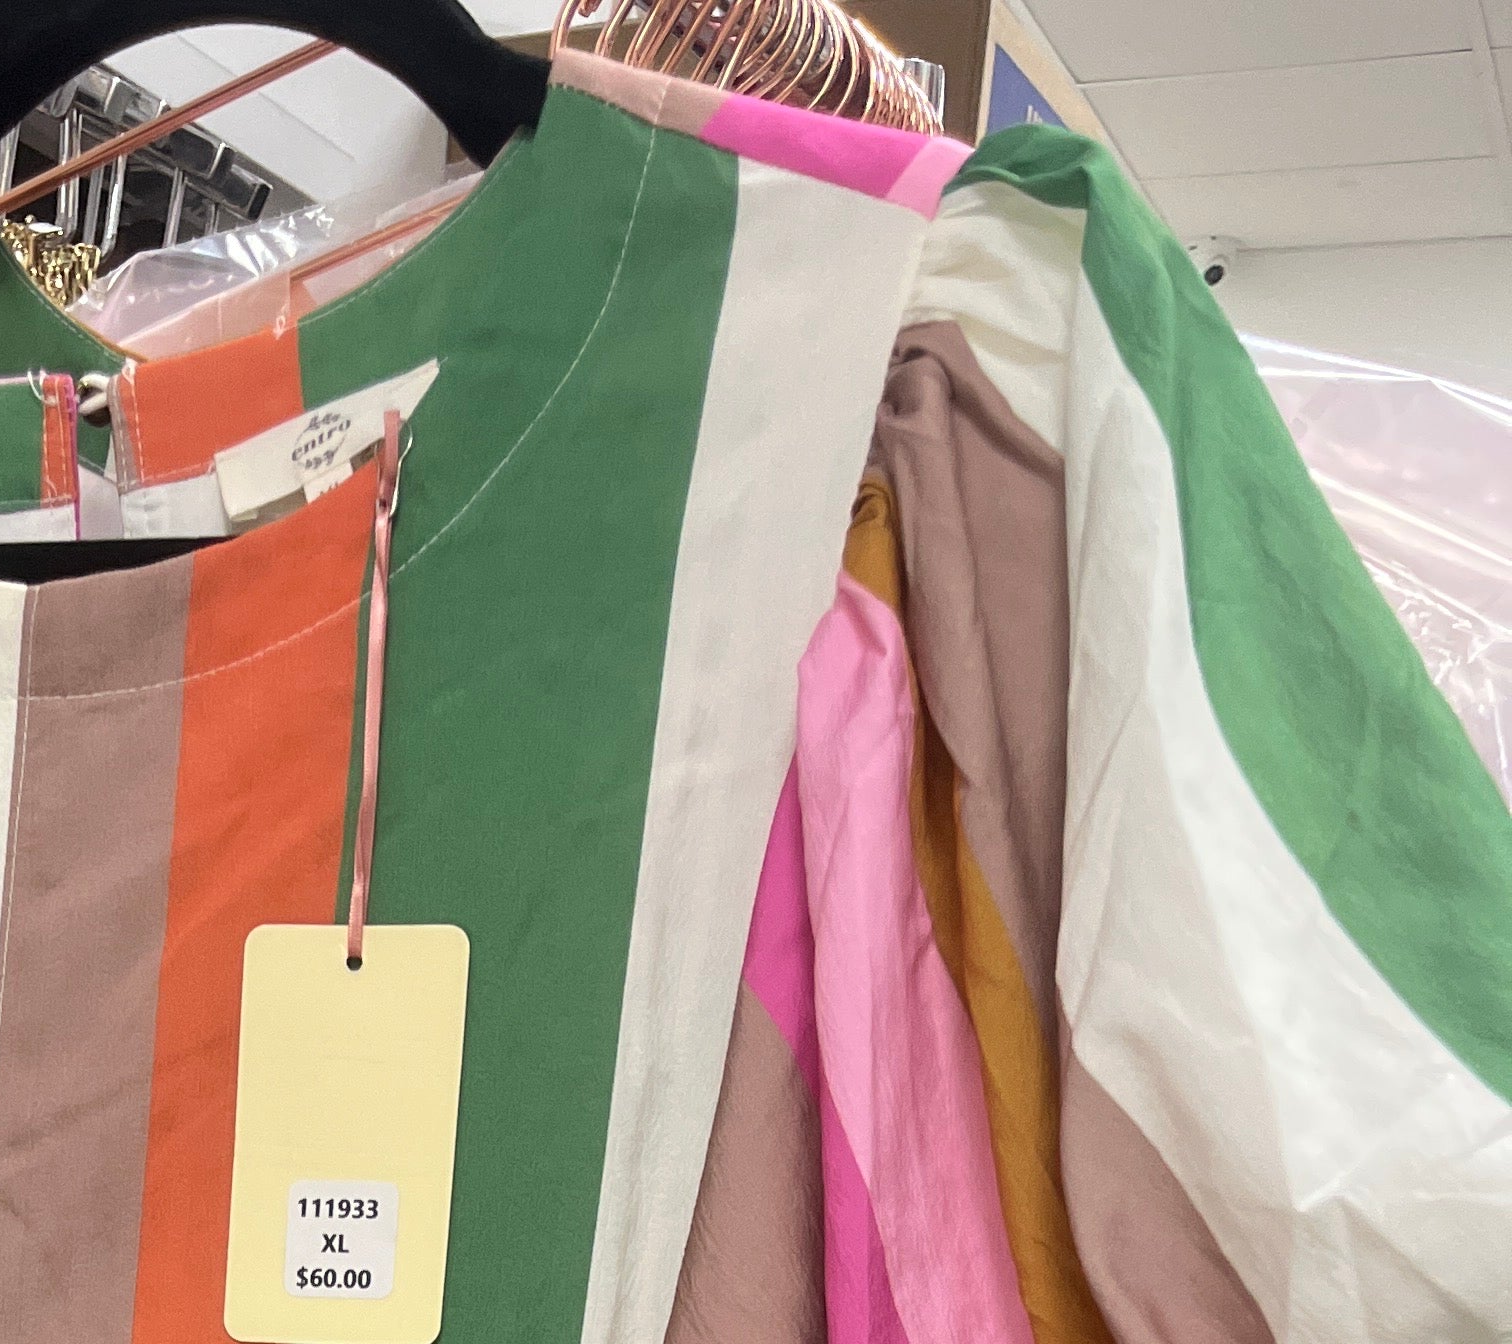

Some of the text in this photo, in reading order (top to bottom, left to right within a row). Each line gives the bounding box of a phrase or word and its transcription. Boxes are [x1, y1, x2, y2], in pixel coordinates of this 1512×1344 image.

[291, 419, 352, 462] entro
[298, 1198, 379, 1219] 111933
[321, 1233, 350, 1253] XL
[296, 1266, 372, 1289] $60.00
